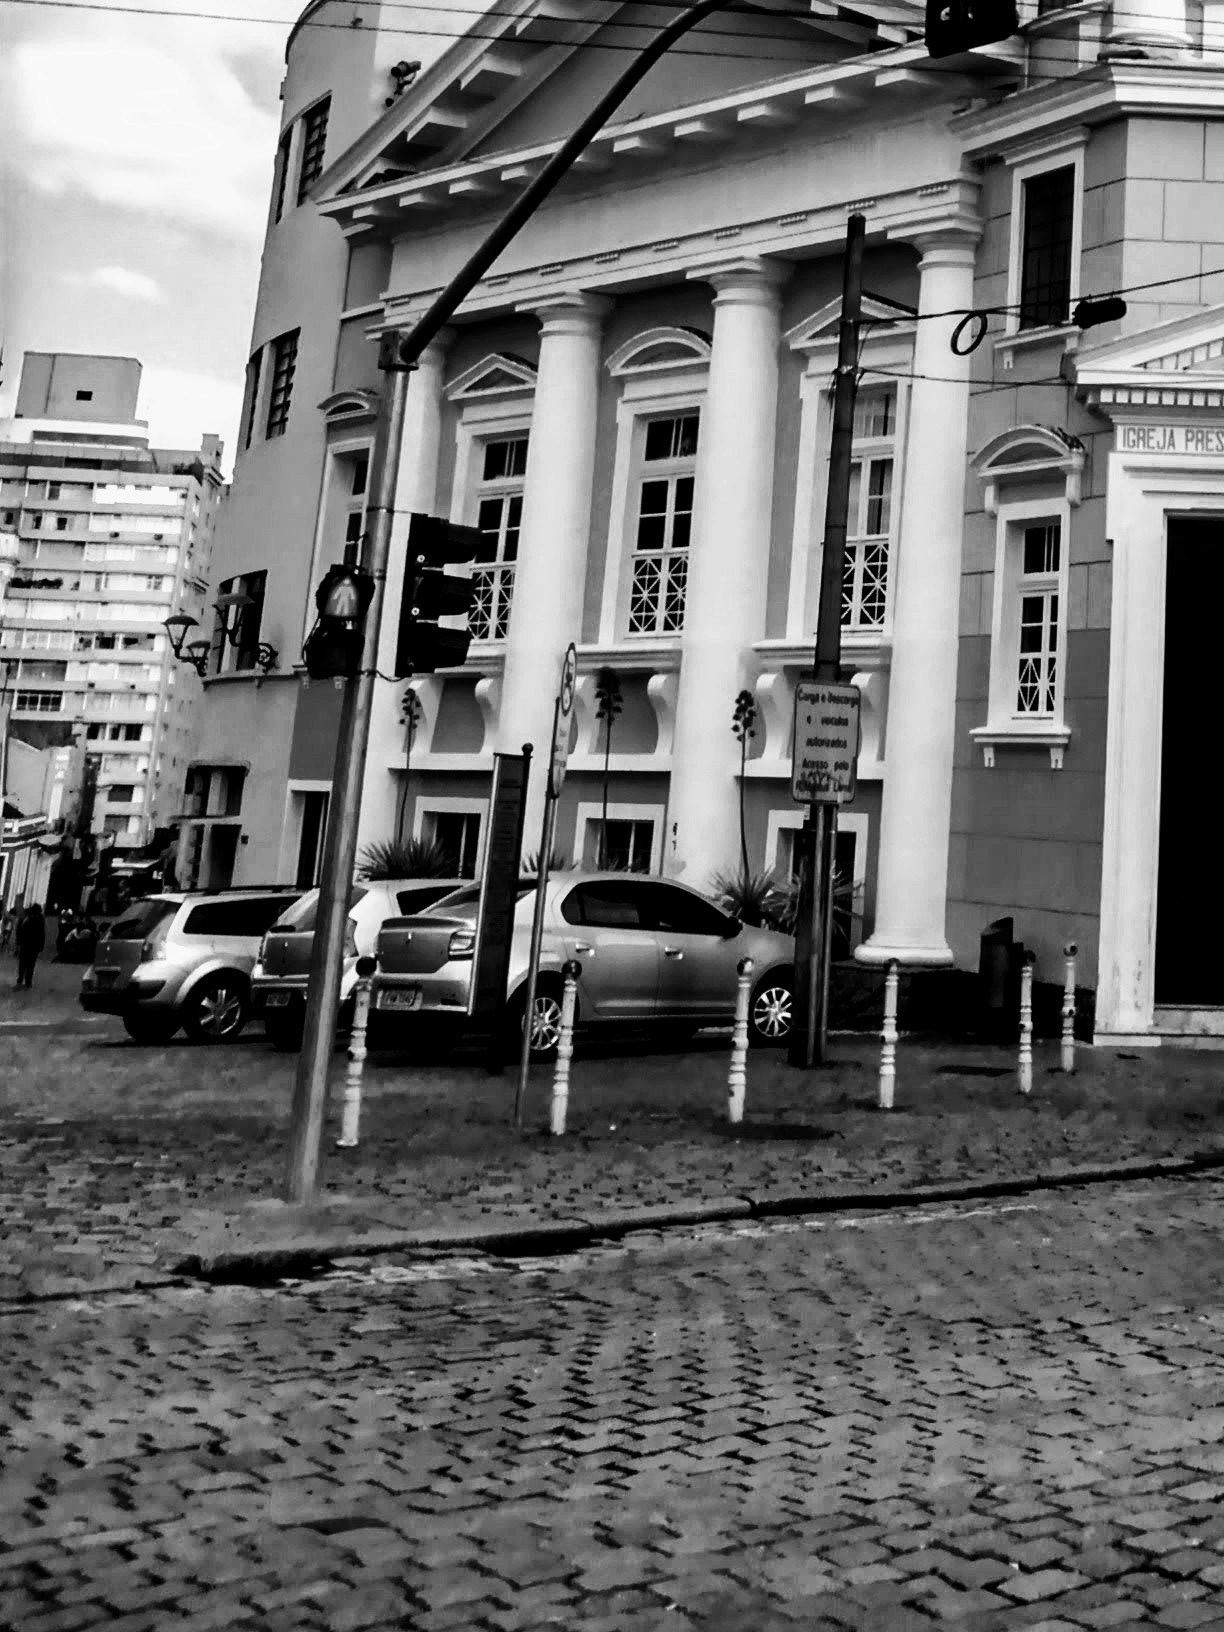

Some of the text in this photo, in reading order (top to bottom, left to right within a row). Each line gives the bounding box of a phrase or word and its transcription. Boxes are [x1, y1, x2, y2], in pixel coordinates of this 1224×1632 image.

[1122, 426, 1176, 451] IGREJA
[798, 689, 819, 705] Carga
[802, 758, 828, 769] Acesso
